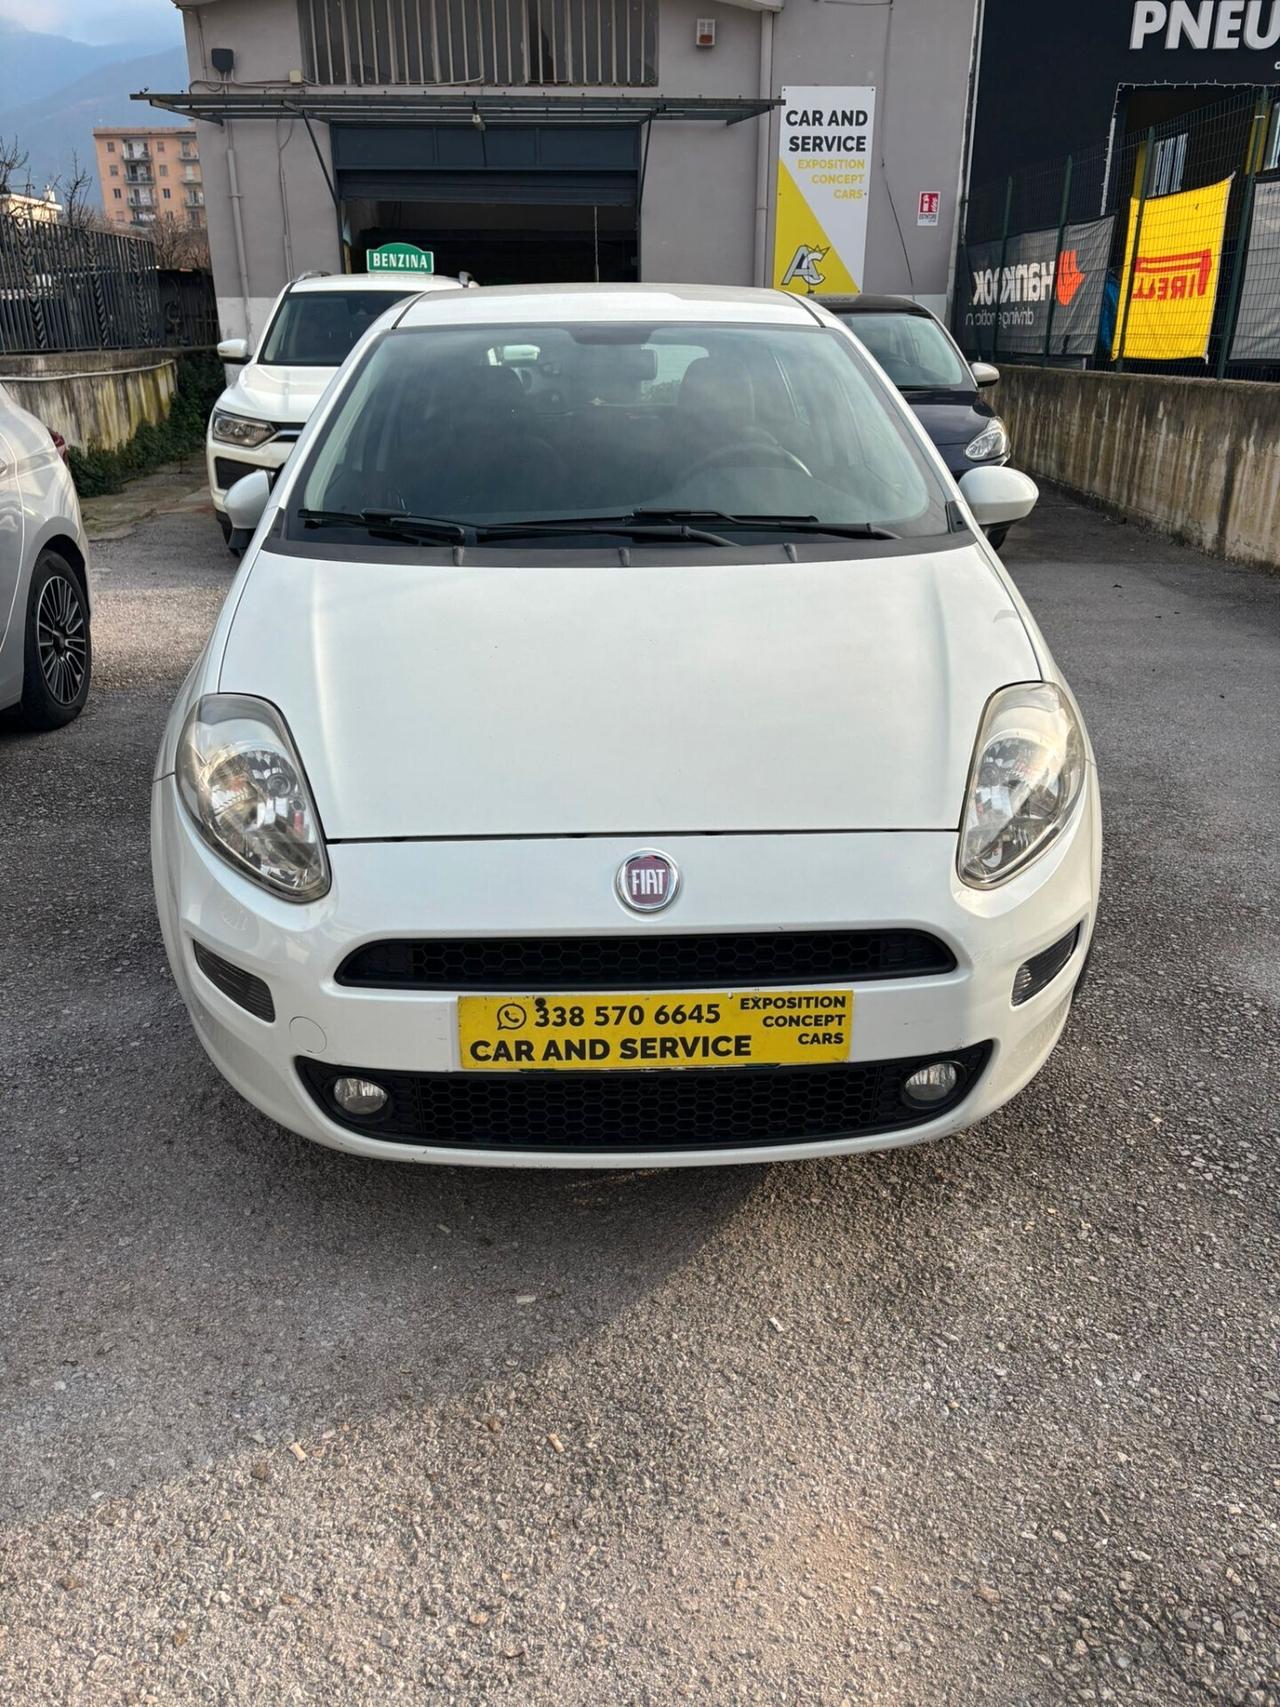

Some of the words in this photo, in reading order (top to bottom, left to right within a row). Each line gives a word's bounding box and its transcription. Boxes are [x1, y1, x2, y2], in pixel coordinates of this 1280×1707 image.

[1130, 0, 1280, 50] PNEU
[786, 110, 824, 127] CAR
[827, 110, 868, 127] AND
[789, 135, 867, 152] SERVICE
[798, 159, 865, 169] EXPOSITION
[811, 174, 864, 184] CONCEPT
[833, 189, 864, 199] CARS
[373, 252, 428, 269] BENZINA
[631, 869, 666, 896] FIAT
[740, 996, 847, 1011] EXPOSITION
[534, 1004, 585, 1028] 338
[594, 1004, 645, 1027] 570
[654, 1002, 721, 1026] 6645
[762, 1014, 846, 1028] CONCEPT
[797, 1031, 844, 1046] CARS
[469, 1039, 535, 1062] CAR
[542, 1038, 611, 1061] AND
[619, 1034, 753, 1060] SERVICE
